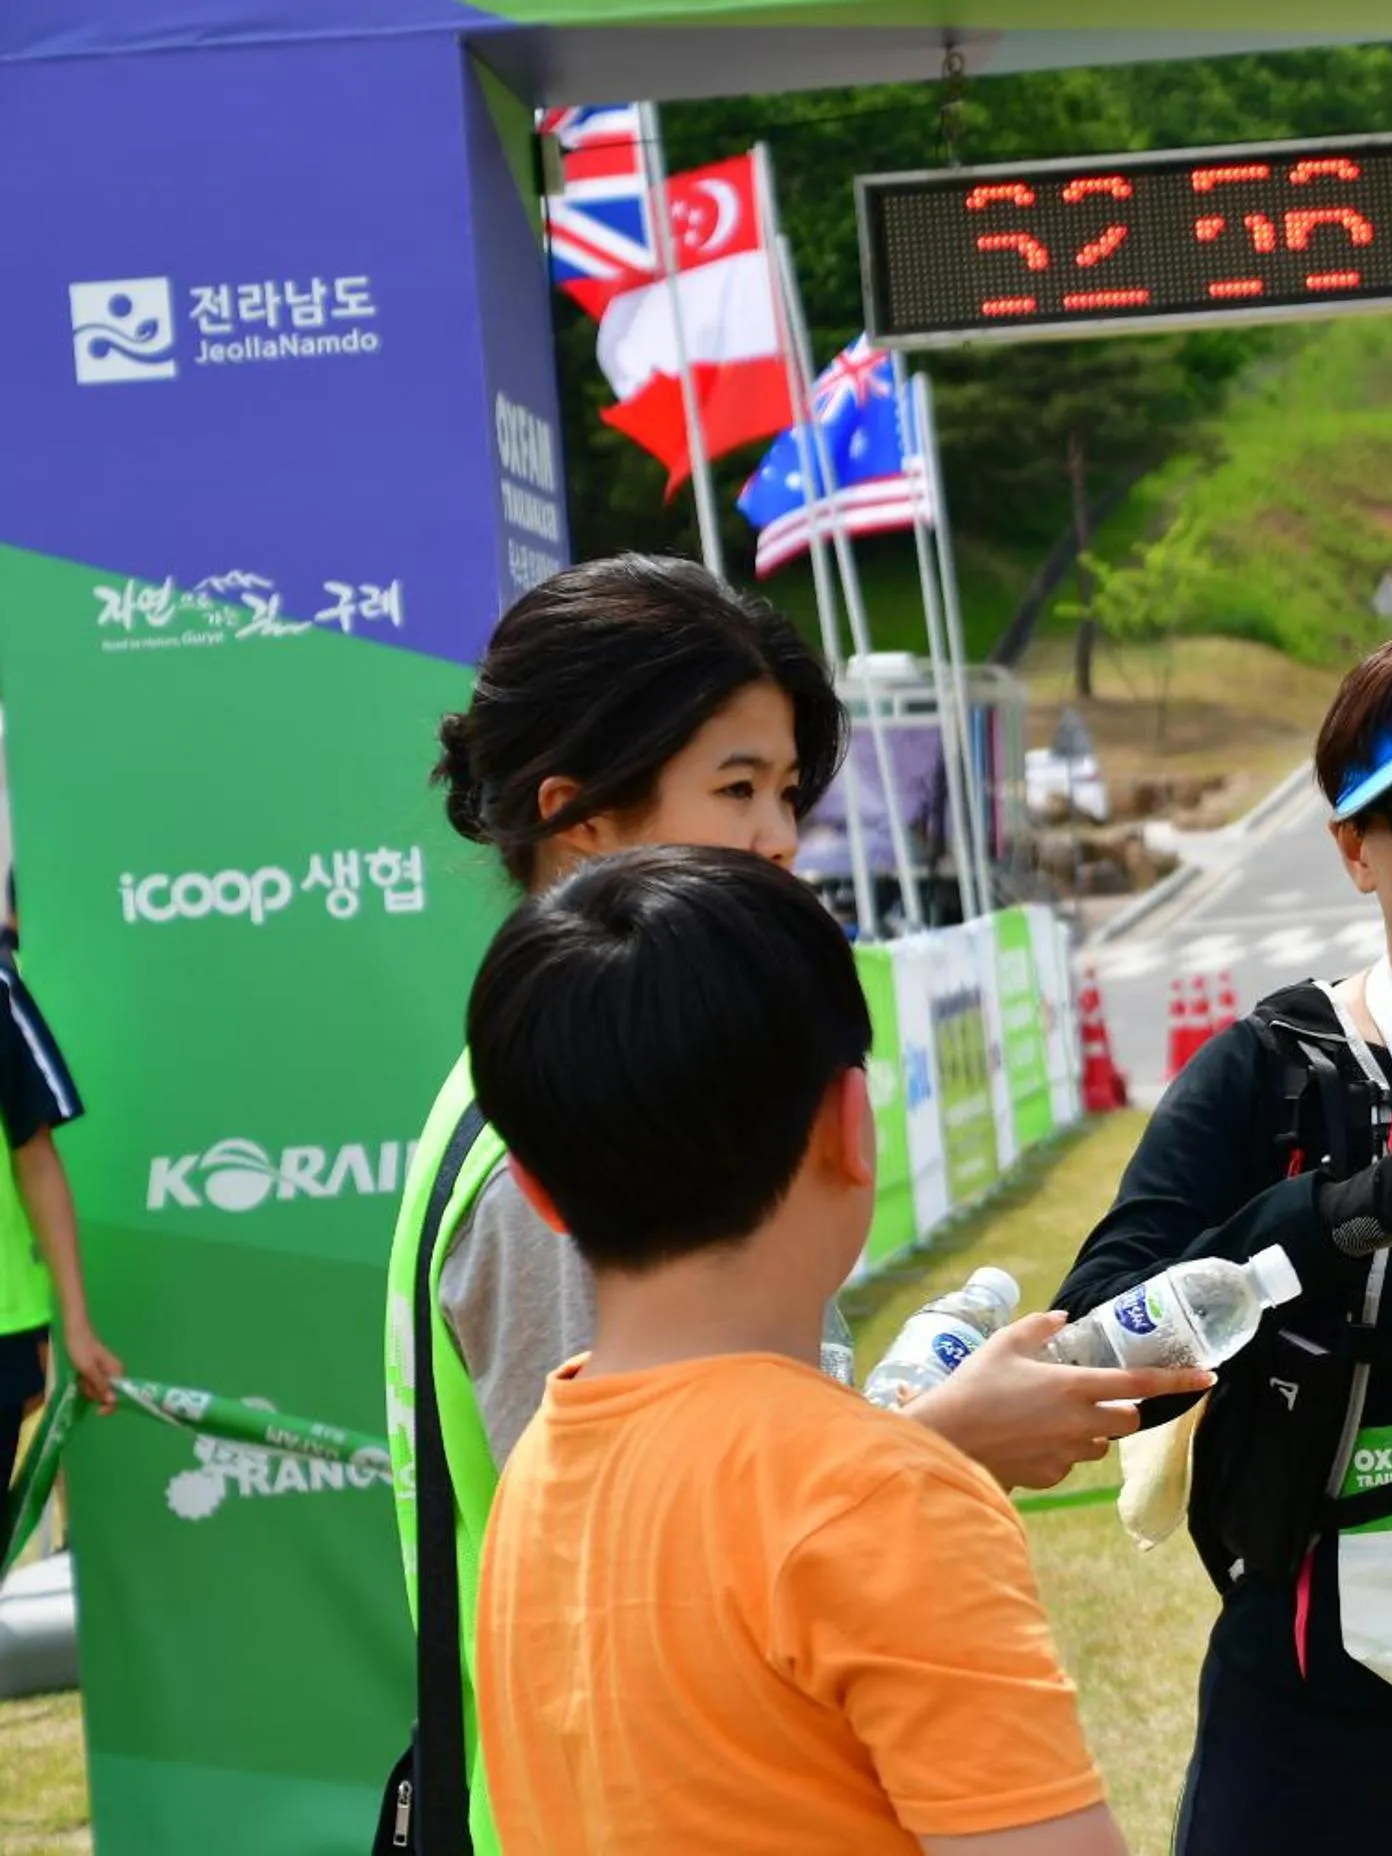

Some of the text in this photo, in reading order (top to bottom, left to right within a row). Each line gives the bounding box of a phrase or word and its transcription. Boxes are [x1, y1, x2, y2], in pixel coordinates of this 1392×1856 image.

[189, 275, 376, 333] 전라남도
[194, 330, 379, 364] JeollaNamdo
[301, 845, 425, 919] 생협
